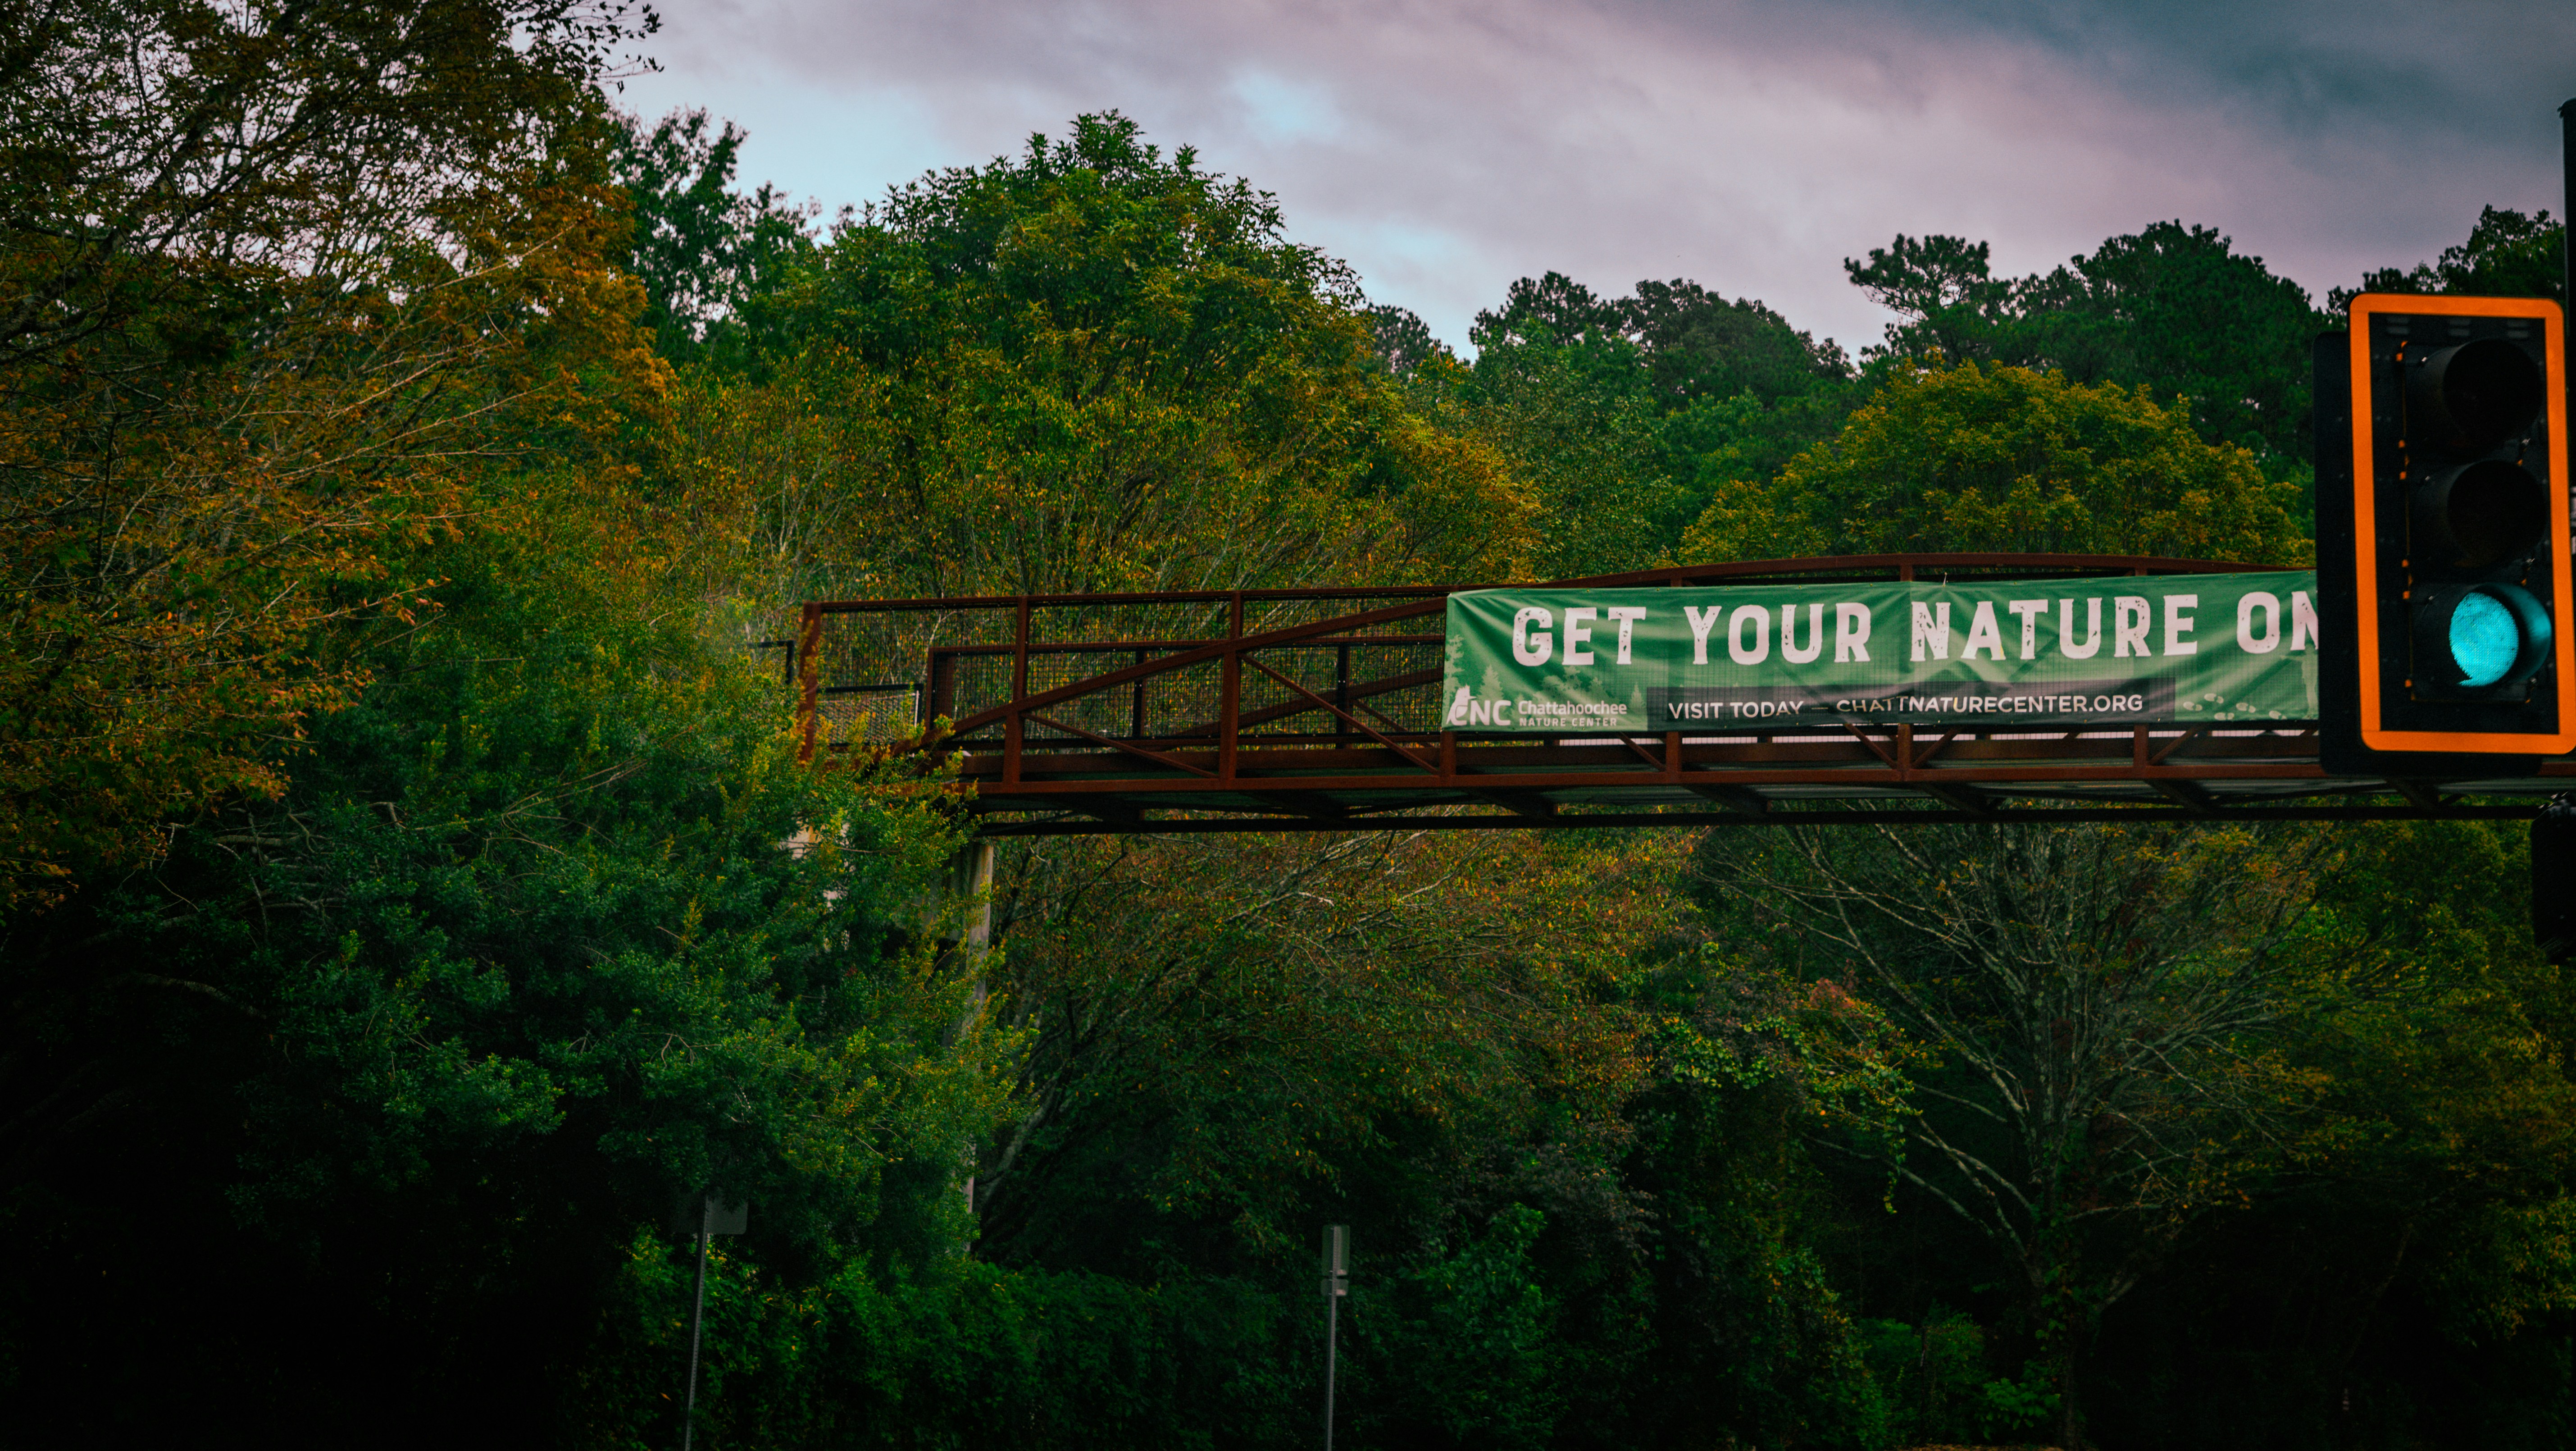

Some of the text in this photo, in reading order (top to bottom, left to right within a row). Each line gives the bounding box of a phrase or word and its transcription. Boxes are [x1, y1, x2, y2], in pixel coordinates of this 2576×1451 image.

[1512, 606, 1647, 666] GET
[1684, 602, 1871, 666] YOUR
[1910, 594, 2198, 662] NATURE
[1449, 700, 1511, 726] CNC
[1518, 700, 1627, 715] Chattahoochee
[1668, 702, 1724, 719] VISIT
[1729, 701, 1804, 718] TODAY
[1836, 694, 2143, 713] CHATTNATURECENTER.ORG
[1519, 717, 1617, 727] NATURE CENTER
